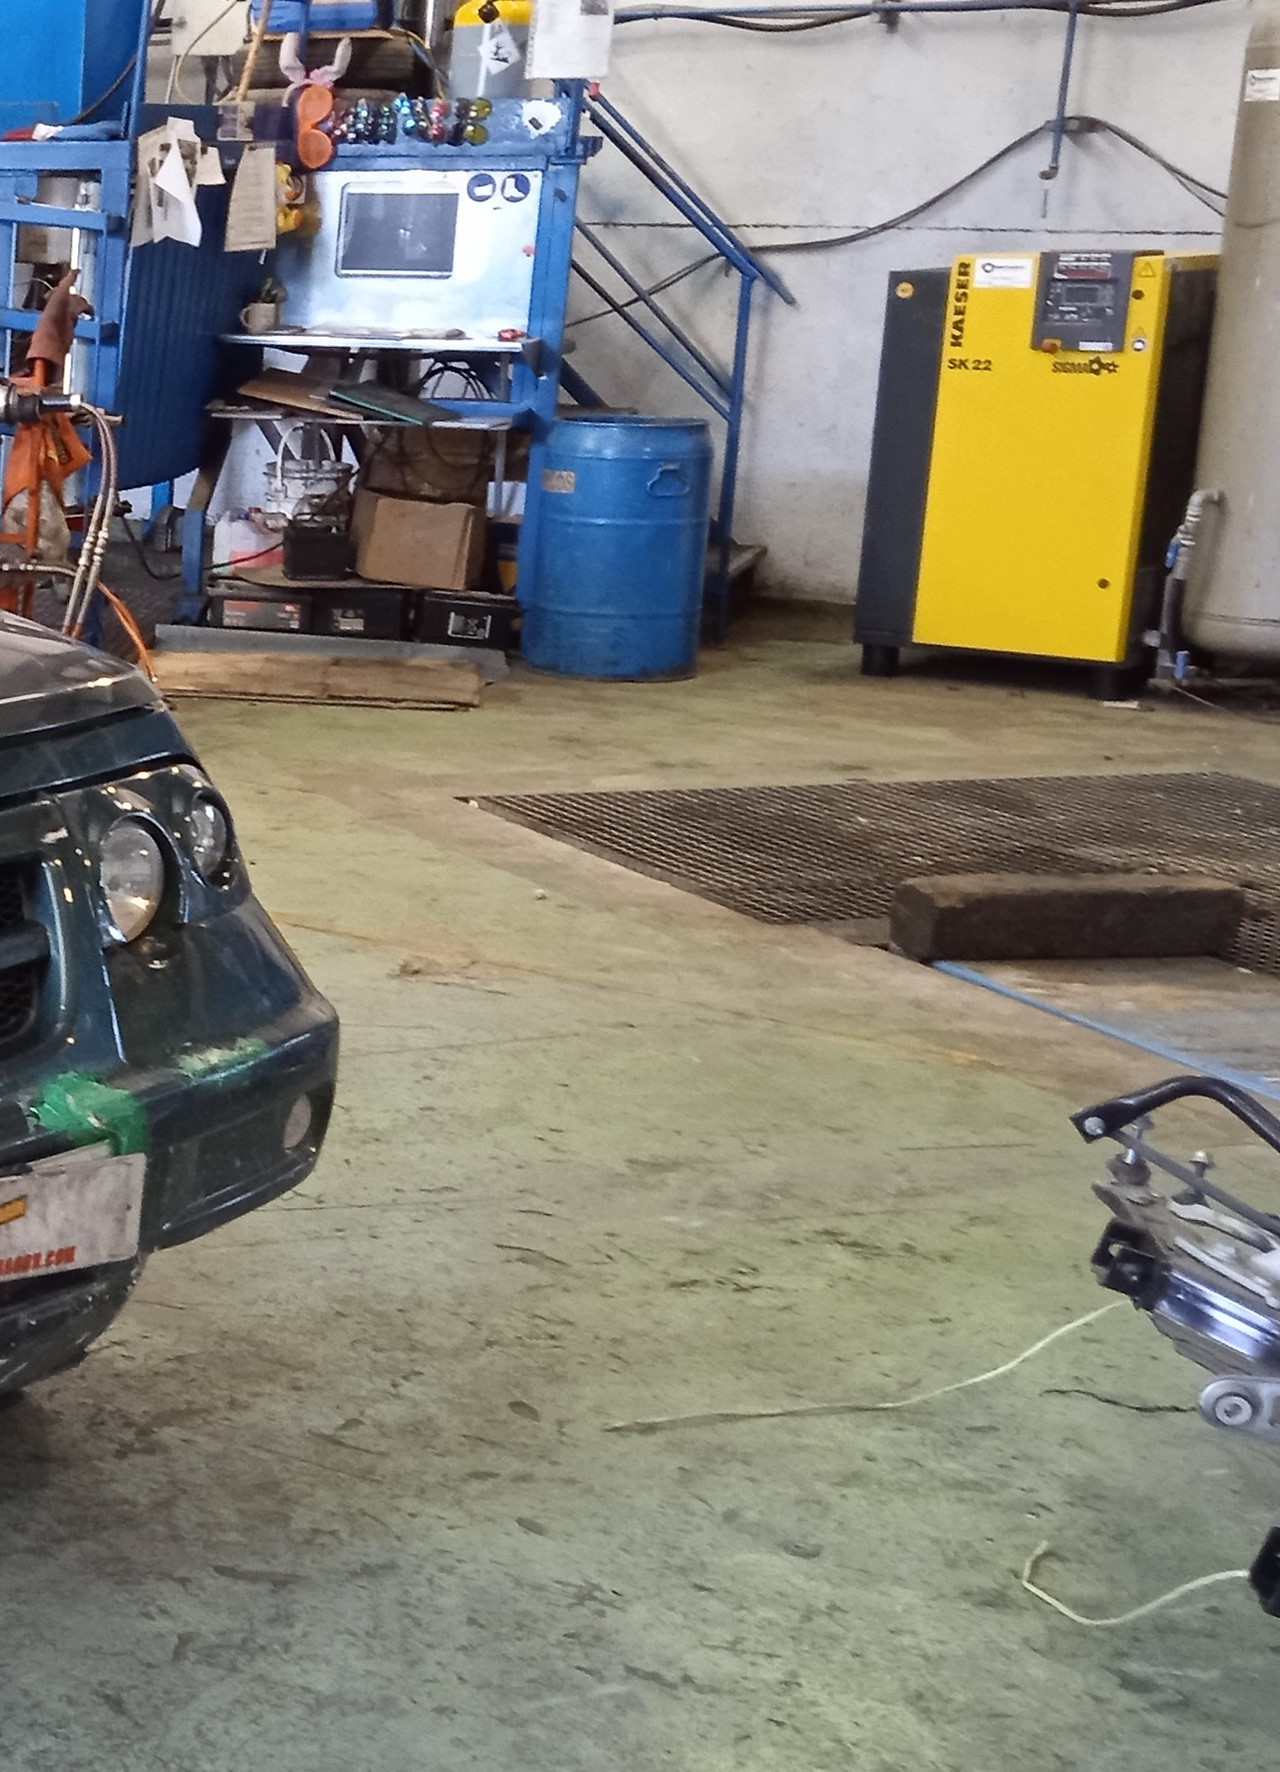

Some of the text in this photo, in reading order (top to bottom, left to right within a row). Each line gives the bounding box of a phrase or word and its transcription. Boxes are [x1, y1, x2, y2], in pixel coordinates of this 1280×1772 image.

[950, 261, 971, 347] KAESER
[947, 358, 992, 371] SK 22
